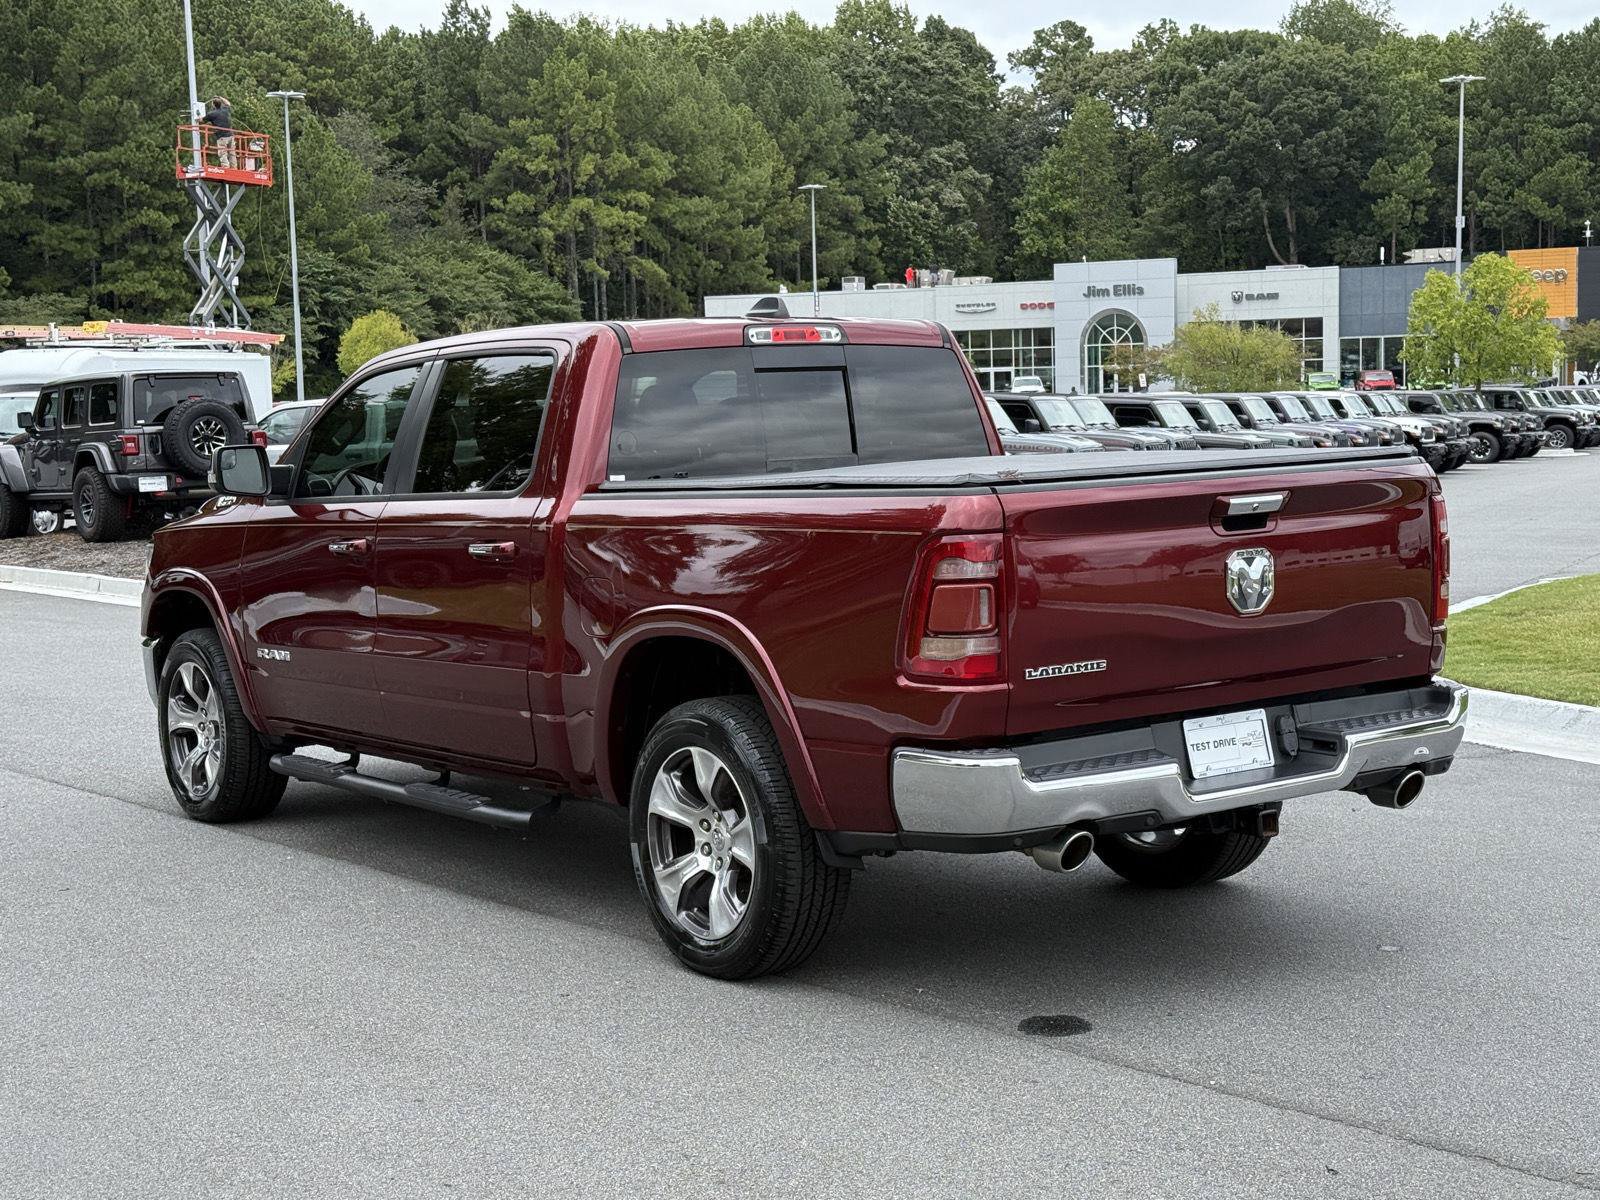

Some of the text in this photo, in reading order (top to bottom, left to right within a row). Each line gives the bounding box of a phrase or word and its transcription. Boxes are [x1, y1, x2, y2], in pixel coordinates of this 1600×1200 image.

[1526, 265, 1568, 285] eep
[1082, 283, 1145, 298] Jim Ellis
[1244, 292, 1280, 302] RAM
[1019, 301, 1055, 311] DODG
[256, 647, 291, 662] RAM
[1025, 659, 1107, 680] LARAMIE
[1190, 741, 1211, 752] TEST
[1213, 737, 1238, 749] DRIVE
